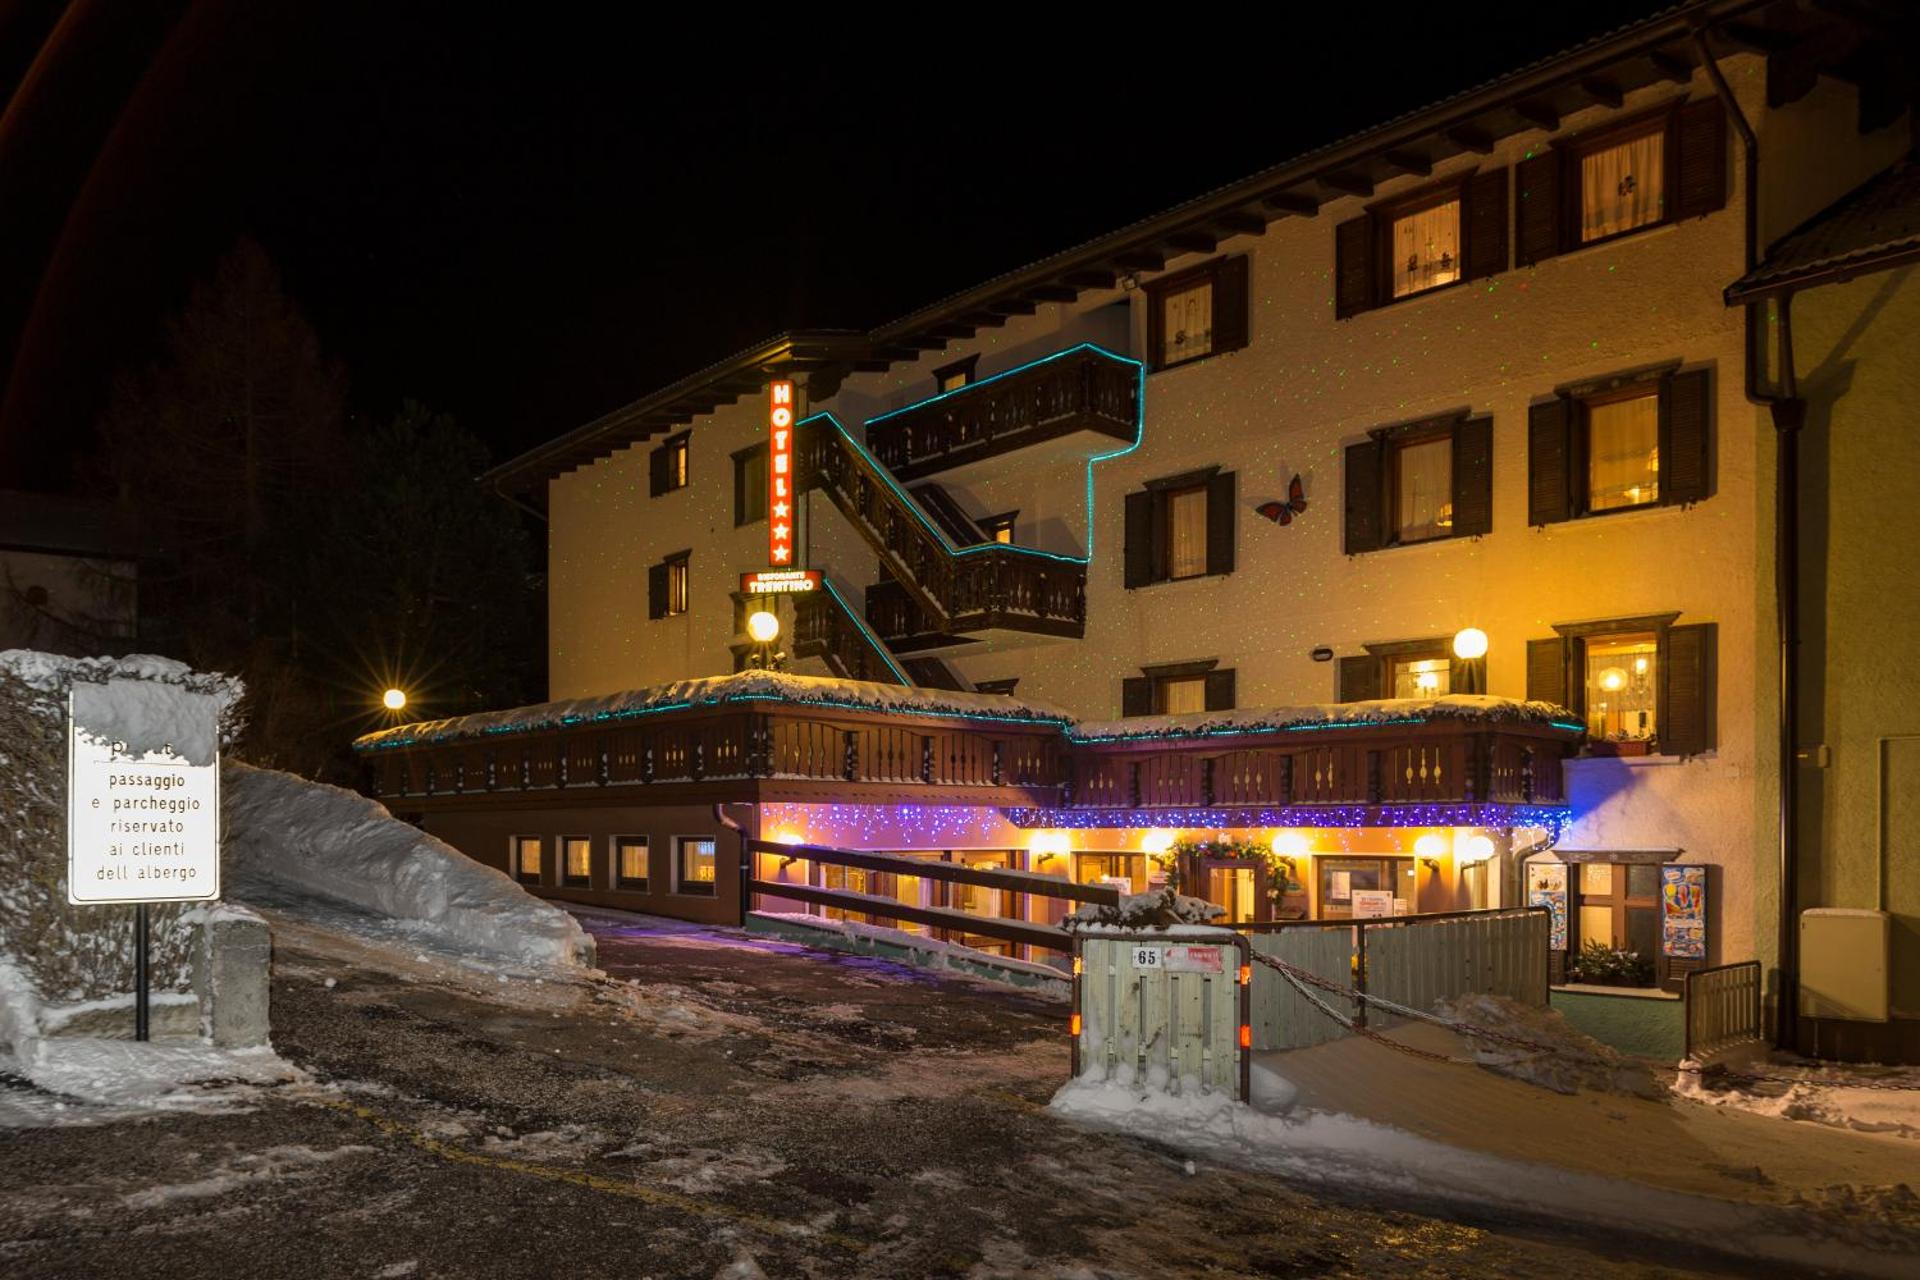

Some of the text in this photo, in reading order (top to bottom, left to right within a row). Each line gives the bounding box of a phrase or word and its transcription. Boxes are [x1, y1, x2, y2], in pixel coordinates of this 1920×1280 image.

[773, 384, 790, 496] HOTEL
[750, 580, 813, 593] TRENTINO
[109, 773, 185, 790] passaggio
[91, 795, 200, 813] e parcheggio
[110, 819, 184, 833] riservato
[109, 842, 184, 856] ai clienti
[138, 864, 197, 881] albergo
[1138, 950, 1156, 965] 65
